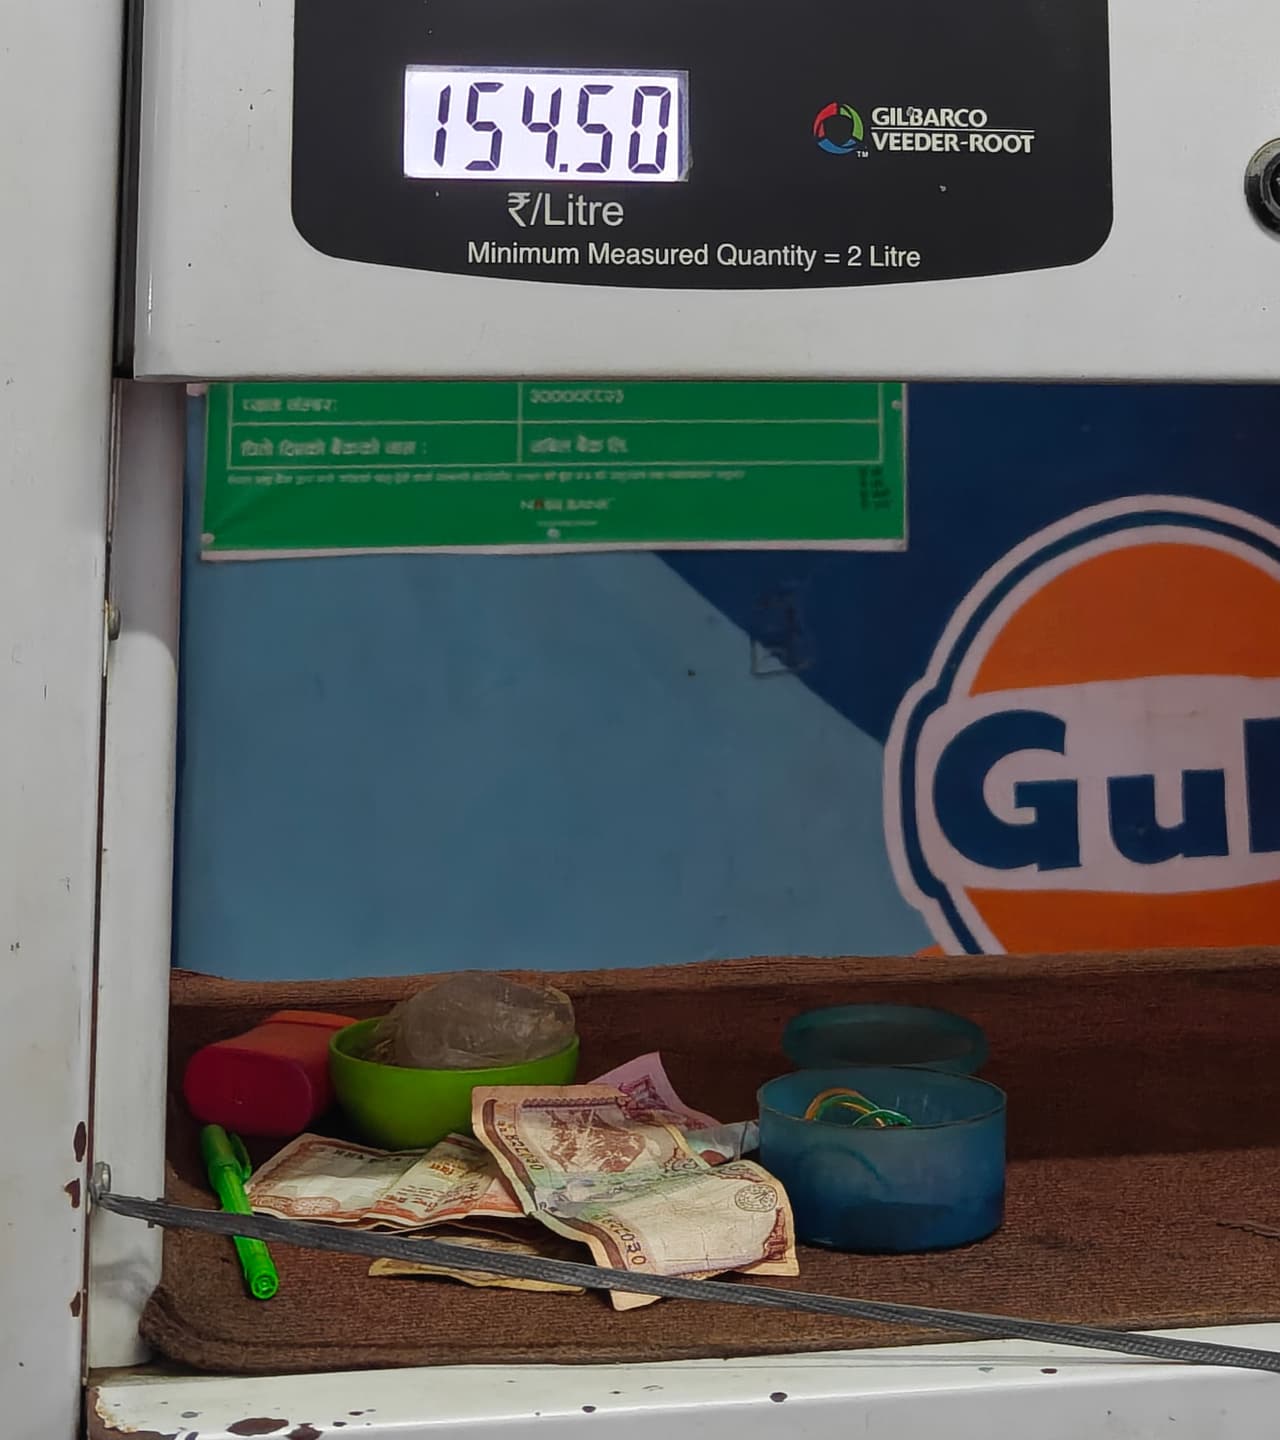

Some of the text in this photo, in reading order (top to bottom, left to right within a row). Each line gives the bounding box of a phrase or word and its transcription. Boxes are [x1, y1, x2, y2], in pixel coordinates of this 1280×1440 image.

[434, 82, 671, 174] 154.50
[871, 107, 988, 128] GILBARCO
[871, 132, 1035, 153] VEEDER-ROOT
[468, 241, 579, 265] Minimum
[588, 242, 708, 266] Measured
[717, 243, 817, 272] Quantity
[847, 246, 862, 267] 2
[869, 245, 921, 268] Litre
